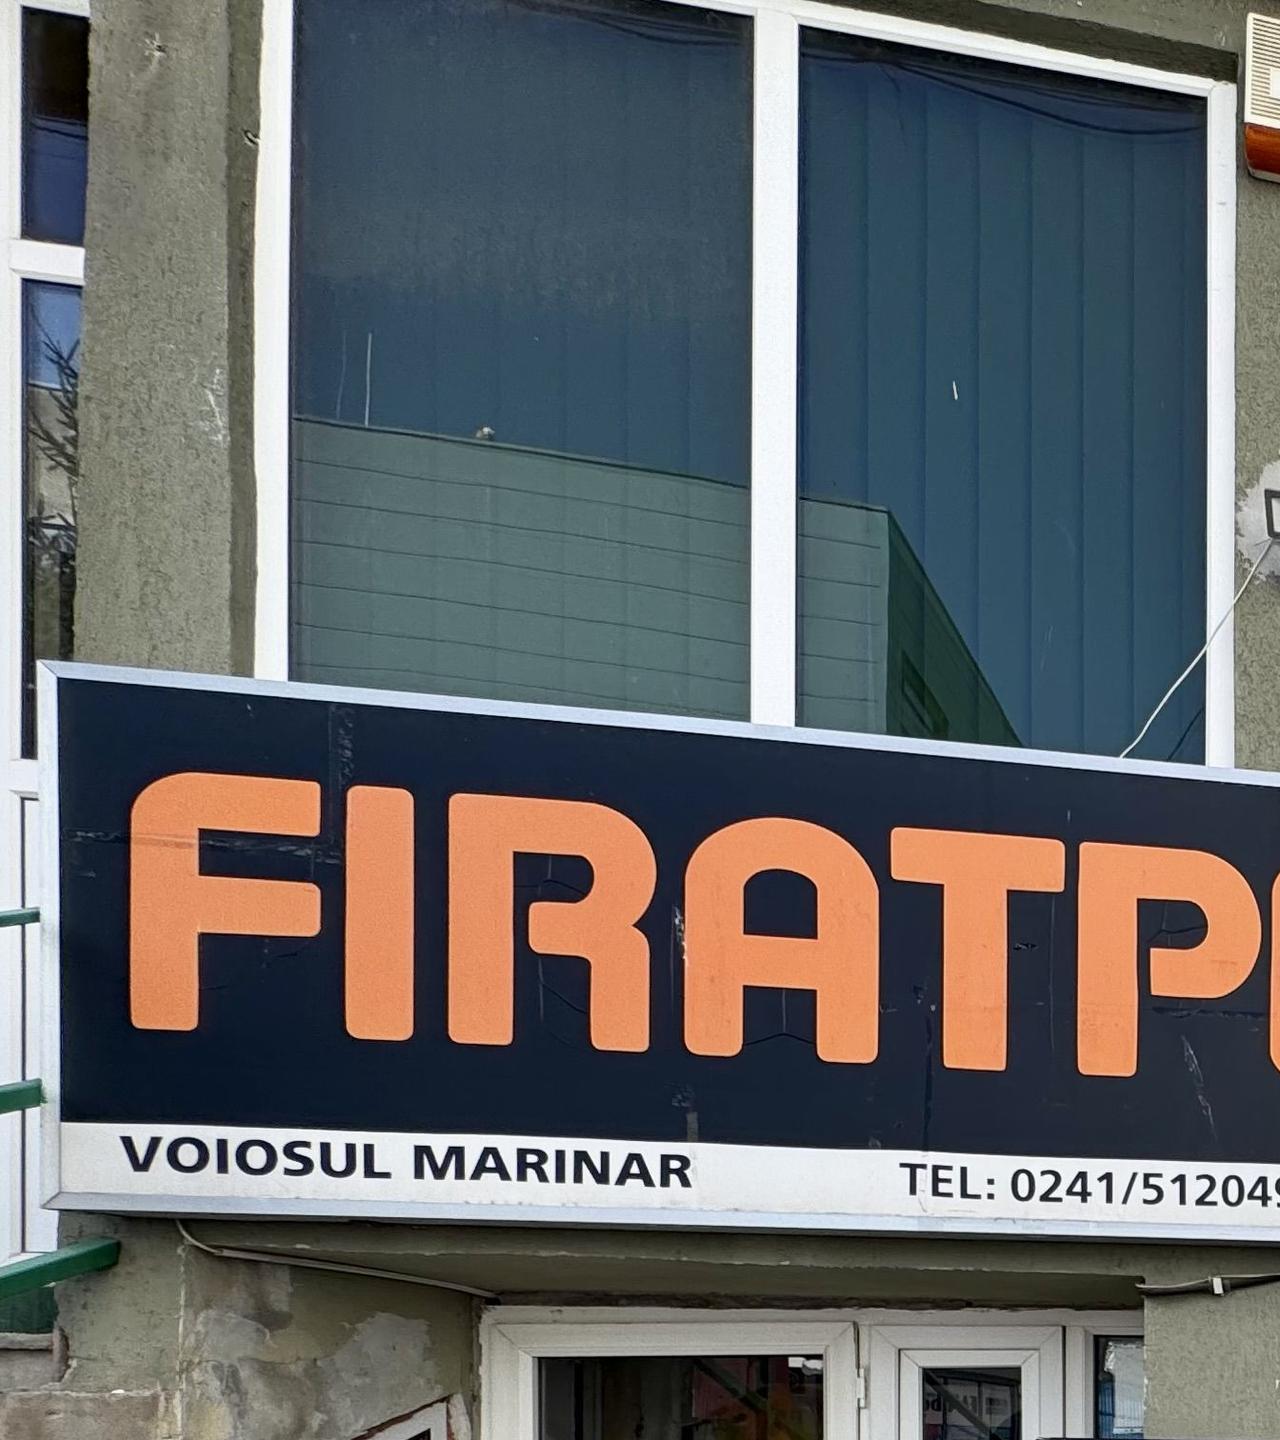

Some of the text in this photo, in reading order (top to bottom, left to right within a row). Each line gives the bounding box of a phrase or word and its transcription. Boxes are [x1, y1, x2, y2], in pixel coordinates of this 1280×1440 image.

[120, 1136, 691, 1188] VOIOSUL MARINAR
[900, 1163, 996, 1200] TEL:
